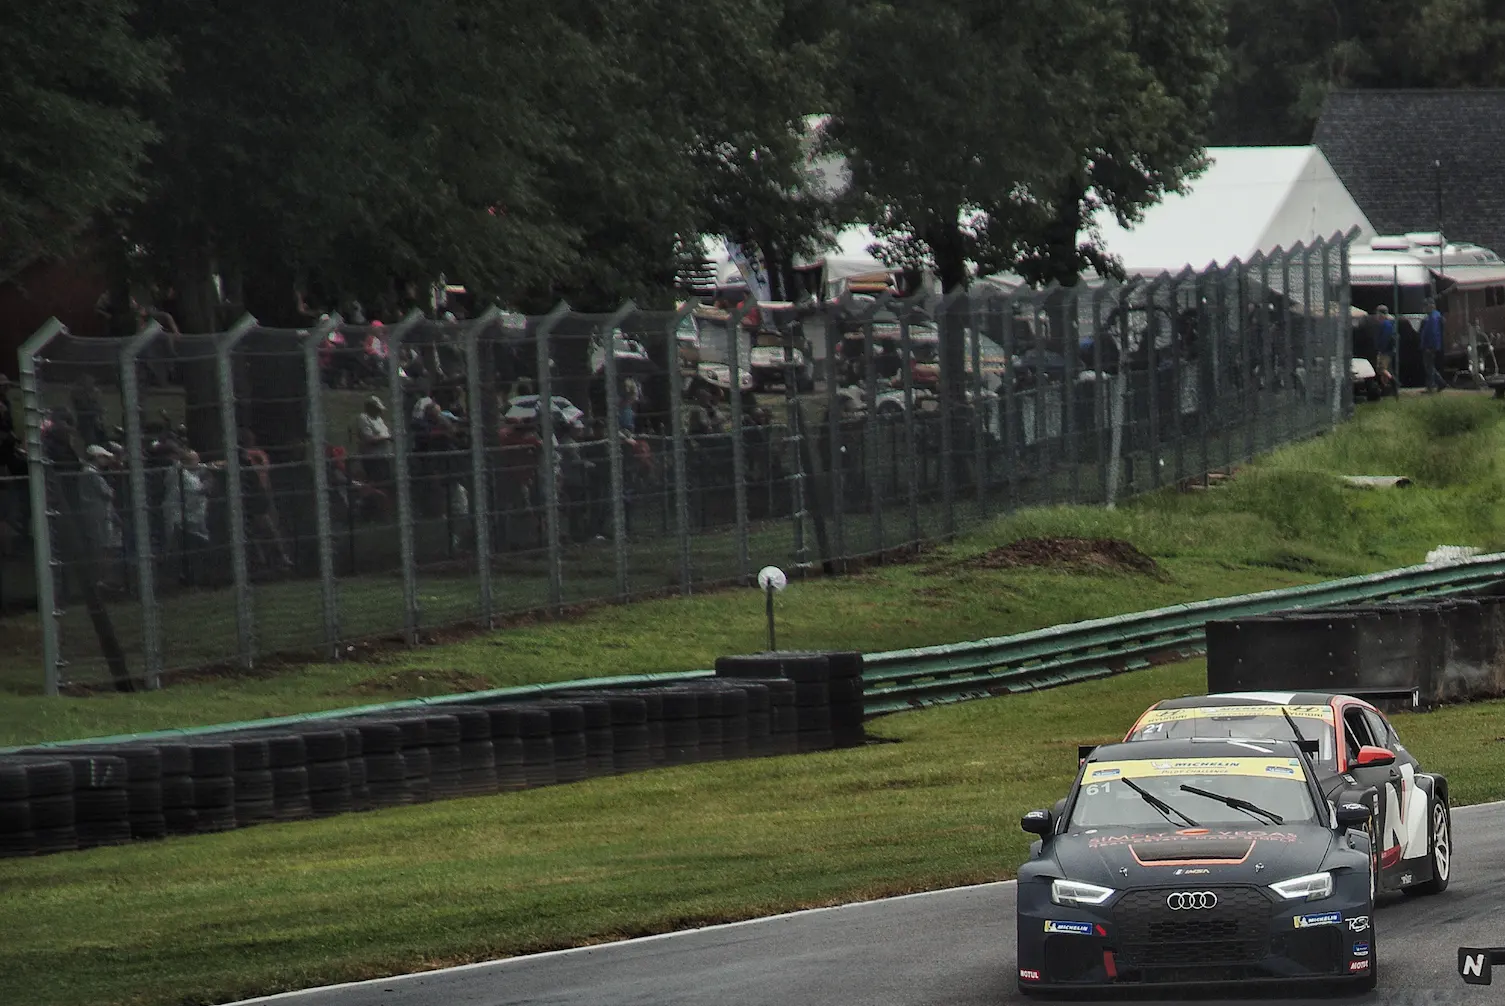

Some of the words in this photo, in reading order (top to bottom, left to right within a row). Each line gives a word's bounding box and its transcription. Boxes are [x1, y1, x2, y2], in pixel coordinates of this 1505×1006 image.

[1144, 723, 1163, 734] 21
[1086, 781, 1110, 796] 61
[1308, 915, 1338, 923] MICHELIN
[1057, 924, 1088, 932] MICHELIN
[1462, 953, 1485, 977] N
[1020, 970, 1039, 979] MOTUL
